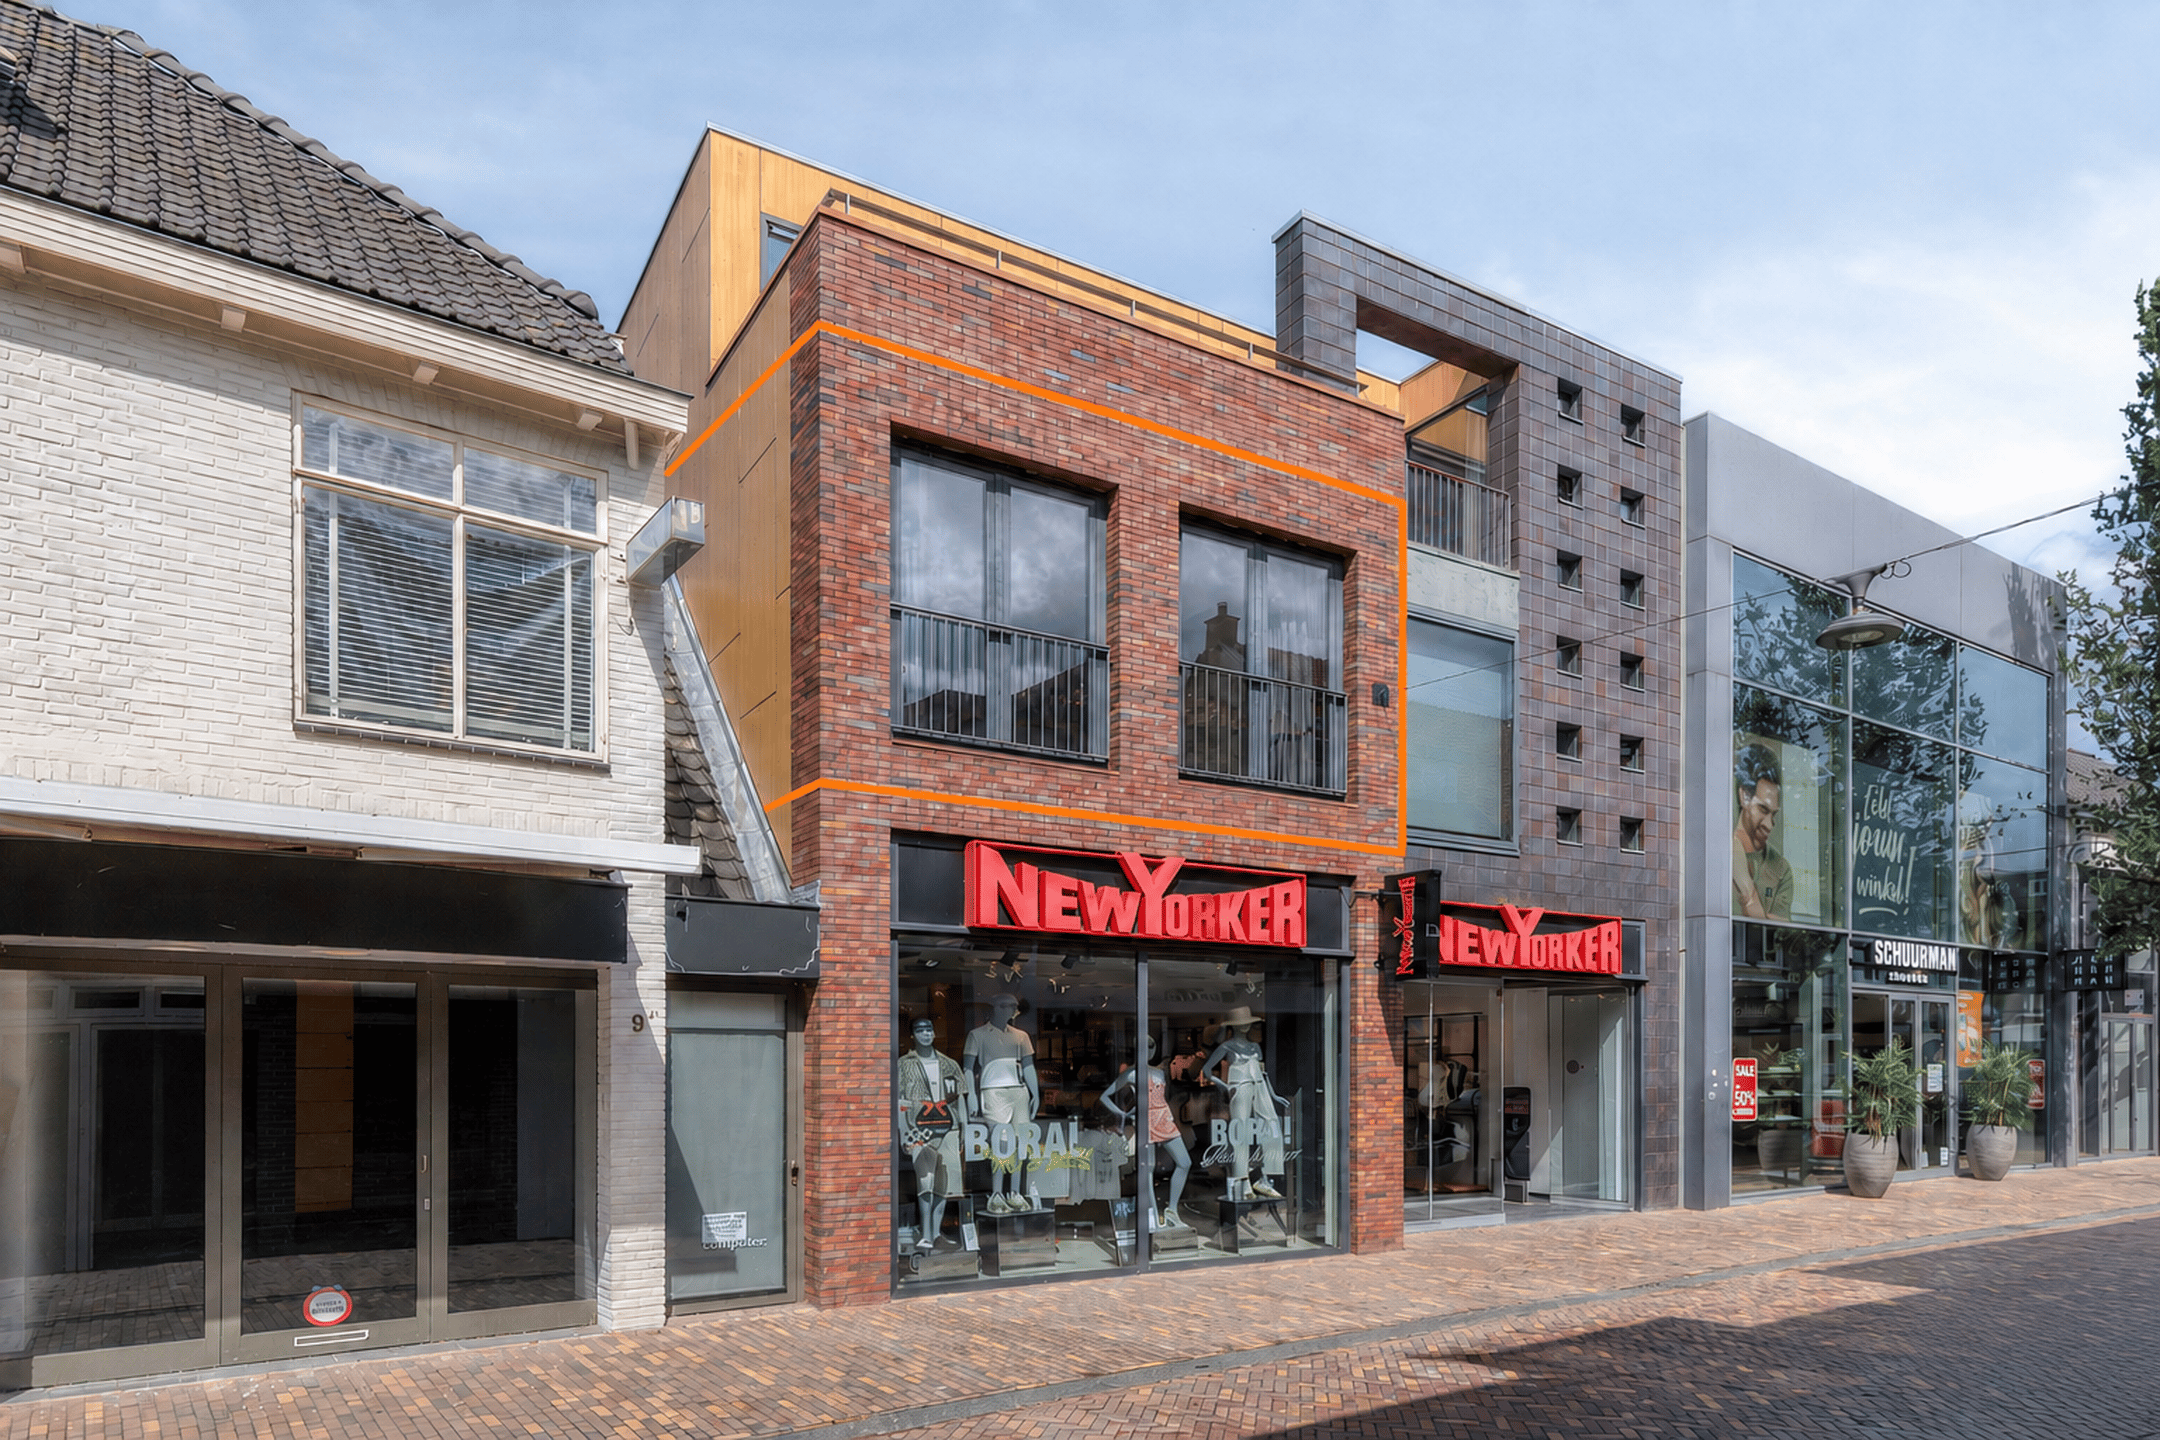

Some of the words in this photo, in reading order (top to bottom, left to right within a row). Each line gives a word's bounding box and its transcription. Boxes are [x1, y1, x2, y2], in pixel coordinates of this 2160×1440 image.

[1874, 939, 1958, 972] SCHUURMAN
[631, 1013, 645, 1033] 9
[1735, 1064, 1755, 1077] SALE
